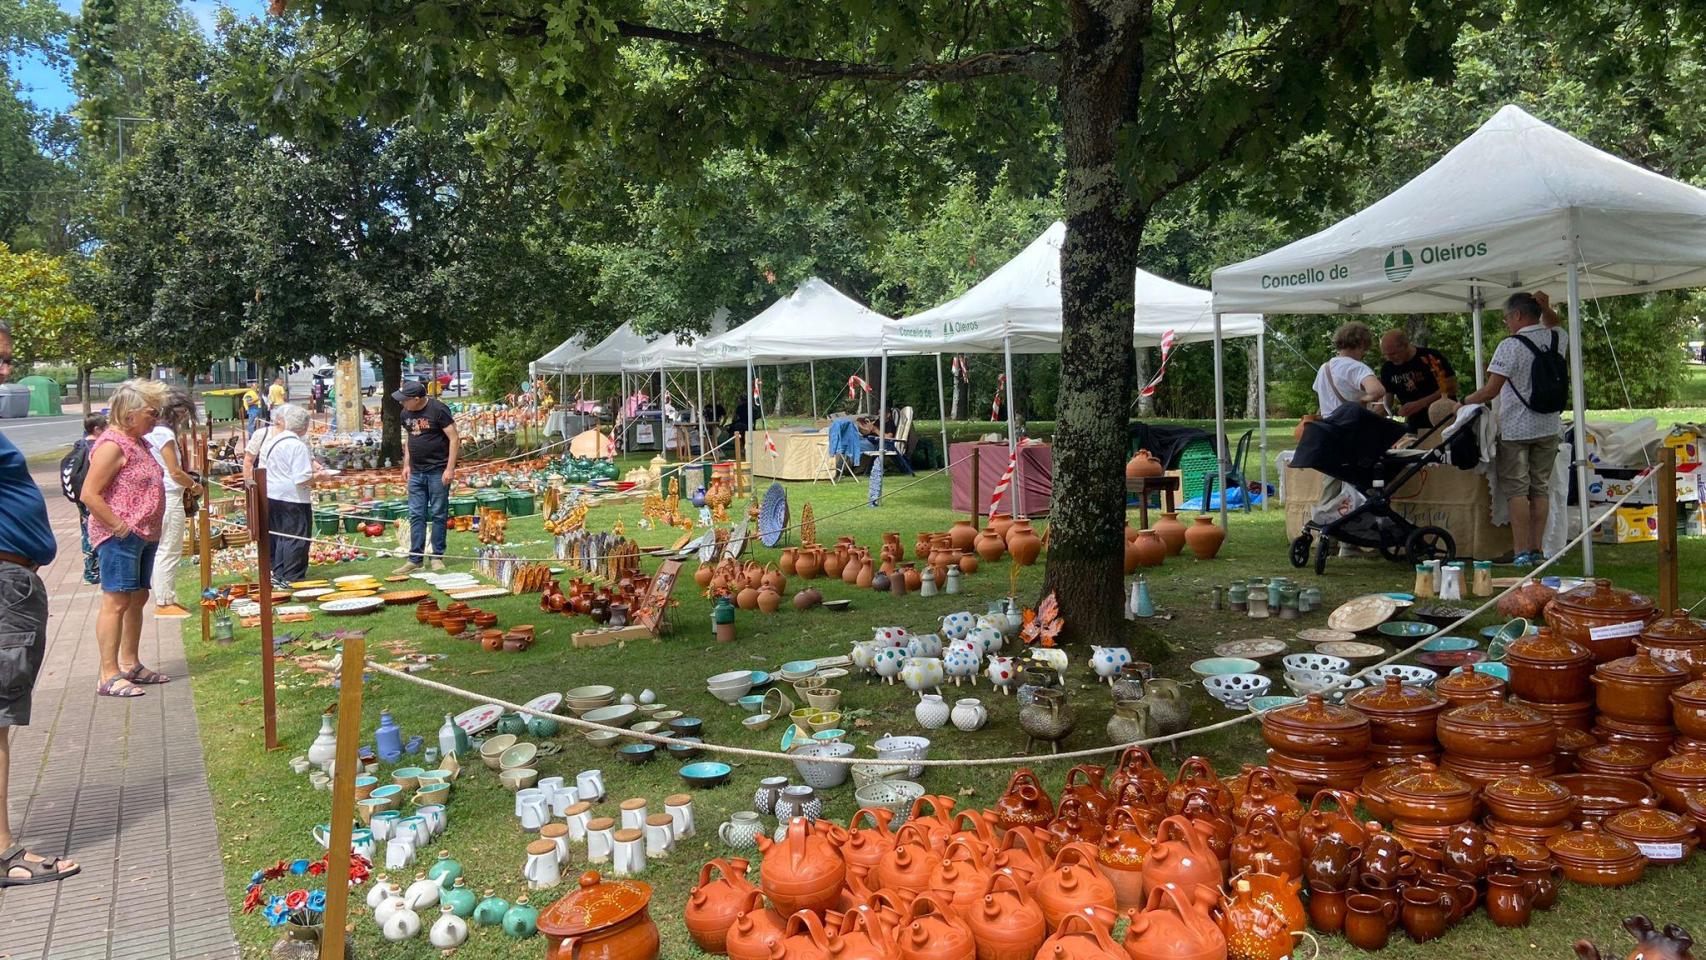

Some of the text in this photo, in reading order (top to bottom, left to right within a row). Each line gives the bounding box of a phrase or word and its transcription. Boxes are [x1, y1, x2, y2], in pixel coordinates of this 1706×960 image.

[1261, 242, 1488, 289] Concello de Oleiros
[899, 326, 923, 337] Concello
[955, 320, 979, 333] Oleiros
